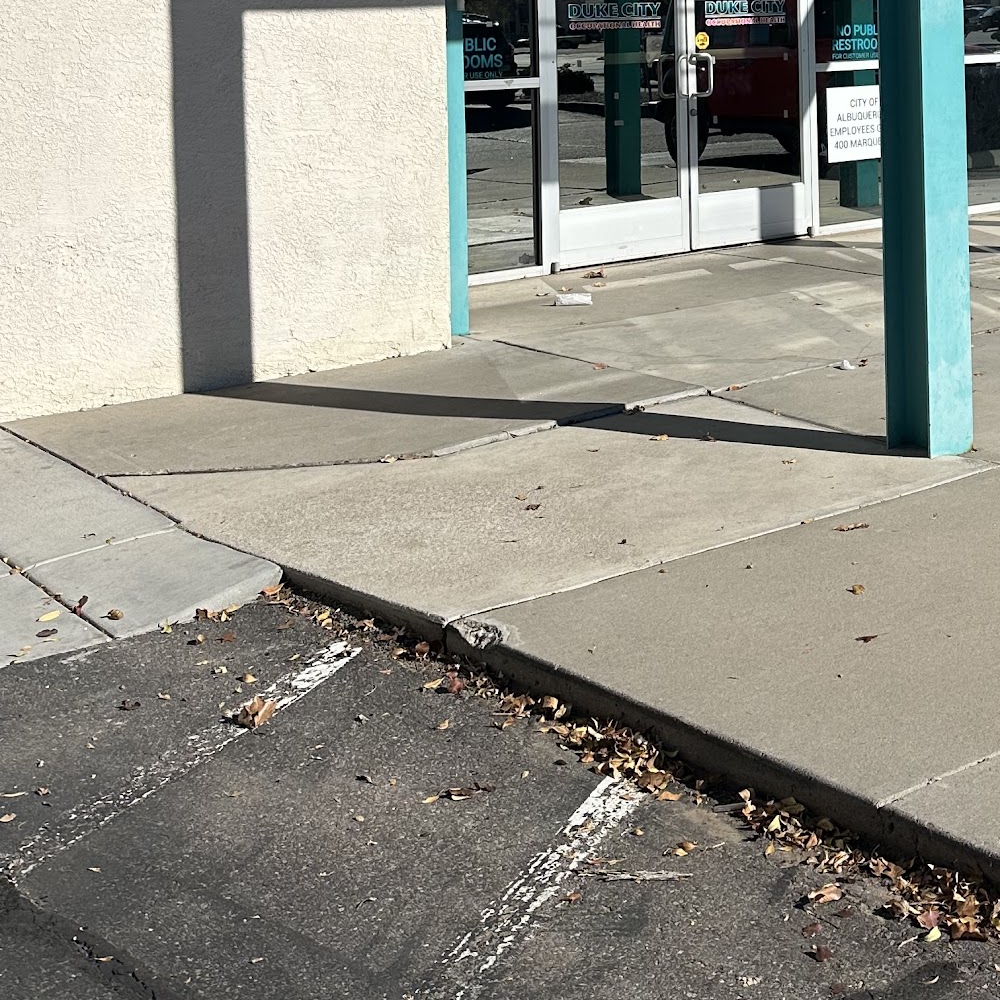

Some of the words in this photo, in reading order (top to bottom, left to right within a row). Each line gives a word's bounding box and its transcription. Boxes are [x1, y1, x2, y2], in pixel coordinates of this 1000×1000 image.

[567, 2, 619, 19] DUKE
[620, 1, 662, 17] CITY
[704, 0, 748, 15] DUKE
[750, 0, 786, 14] CITY
[836, 24, 852, 37] NO
[853, 24, 878, 37] PUBL
[464, 37, 497, 51] BLIC
[832, 38, 878, 51] RESTROO
[484, 70, 503, 78] ONLY
[849, 98, 867, 108] CITY
[868, 97, 878, 107] OF
[836, 110, 881, 122] ALBUQUER
[830, 124, 875, 137] EMPLOYEES
[834, 140, 848, 149] 400
